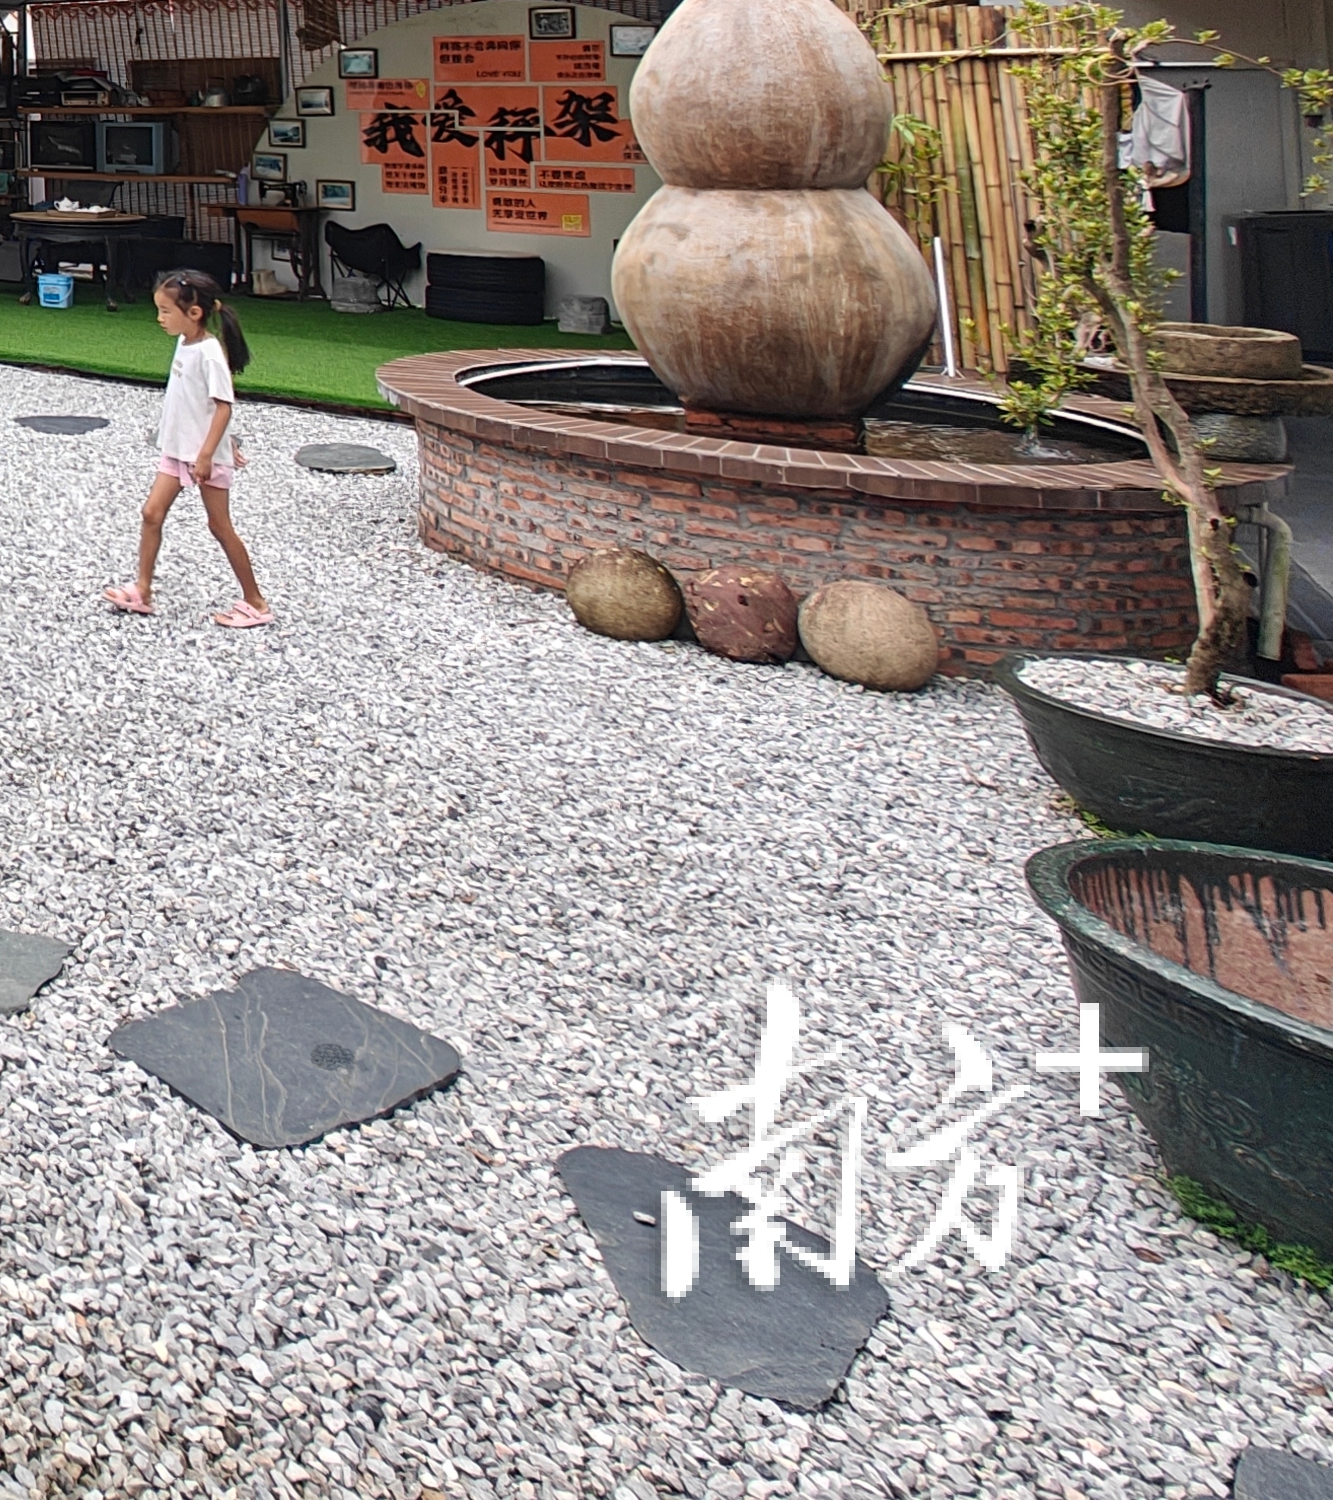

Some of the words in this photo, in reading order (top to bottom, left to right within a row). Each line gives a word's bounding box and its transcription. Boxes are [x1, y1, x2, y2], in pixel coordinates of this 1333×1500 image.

[476, 70, 500, 78] LOVE
[492, 197, 537, 208] 勇敢的人
[492, 209, 548, 221] 先享受世界
